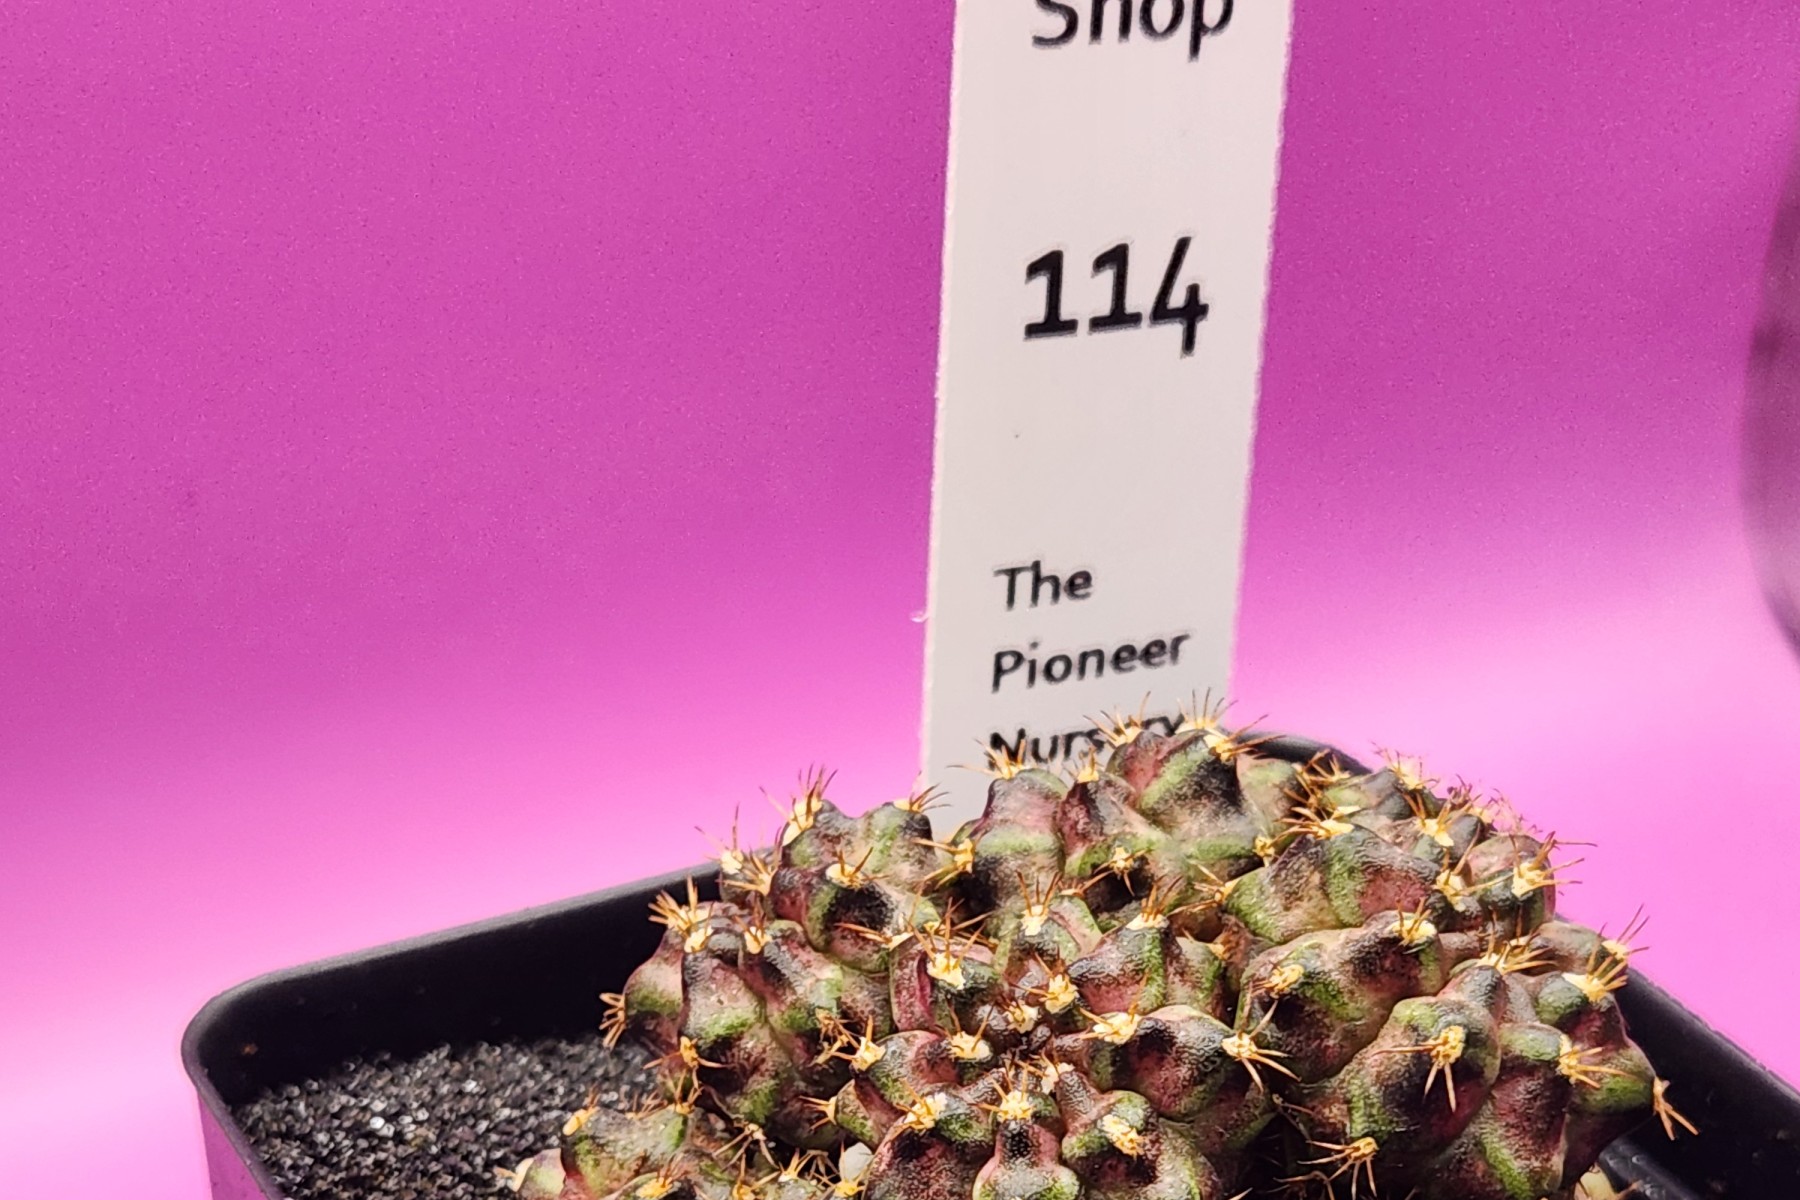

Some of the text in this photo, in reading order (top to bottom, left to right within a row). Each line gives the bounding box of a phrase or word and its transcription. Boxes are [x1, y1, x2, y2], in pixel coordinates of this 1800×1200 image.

[1031, 0, 1235, 62] Shop
[1023, 235, 1210, 359] 114
[992, 559, 1094, 612] The
[990, 631, 1192, 694] Pioneer
